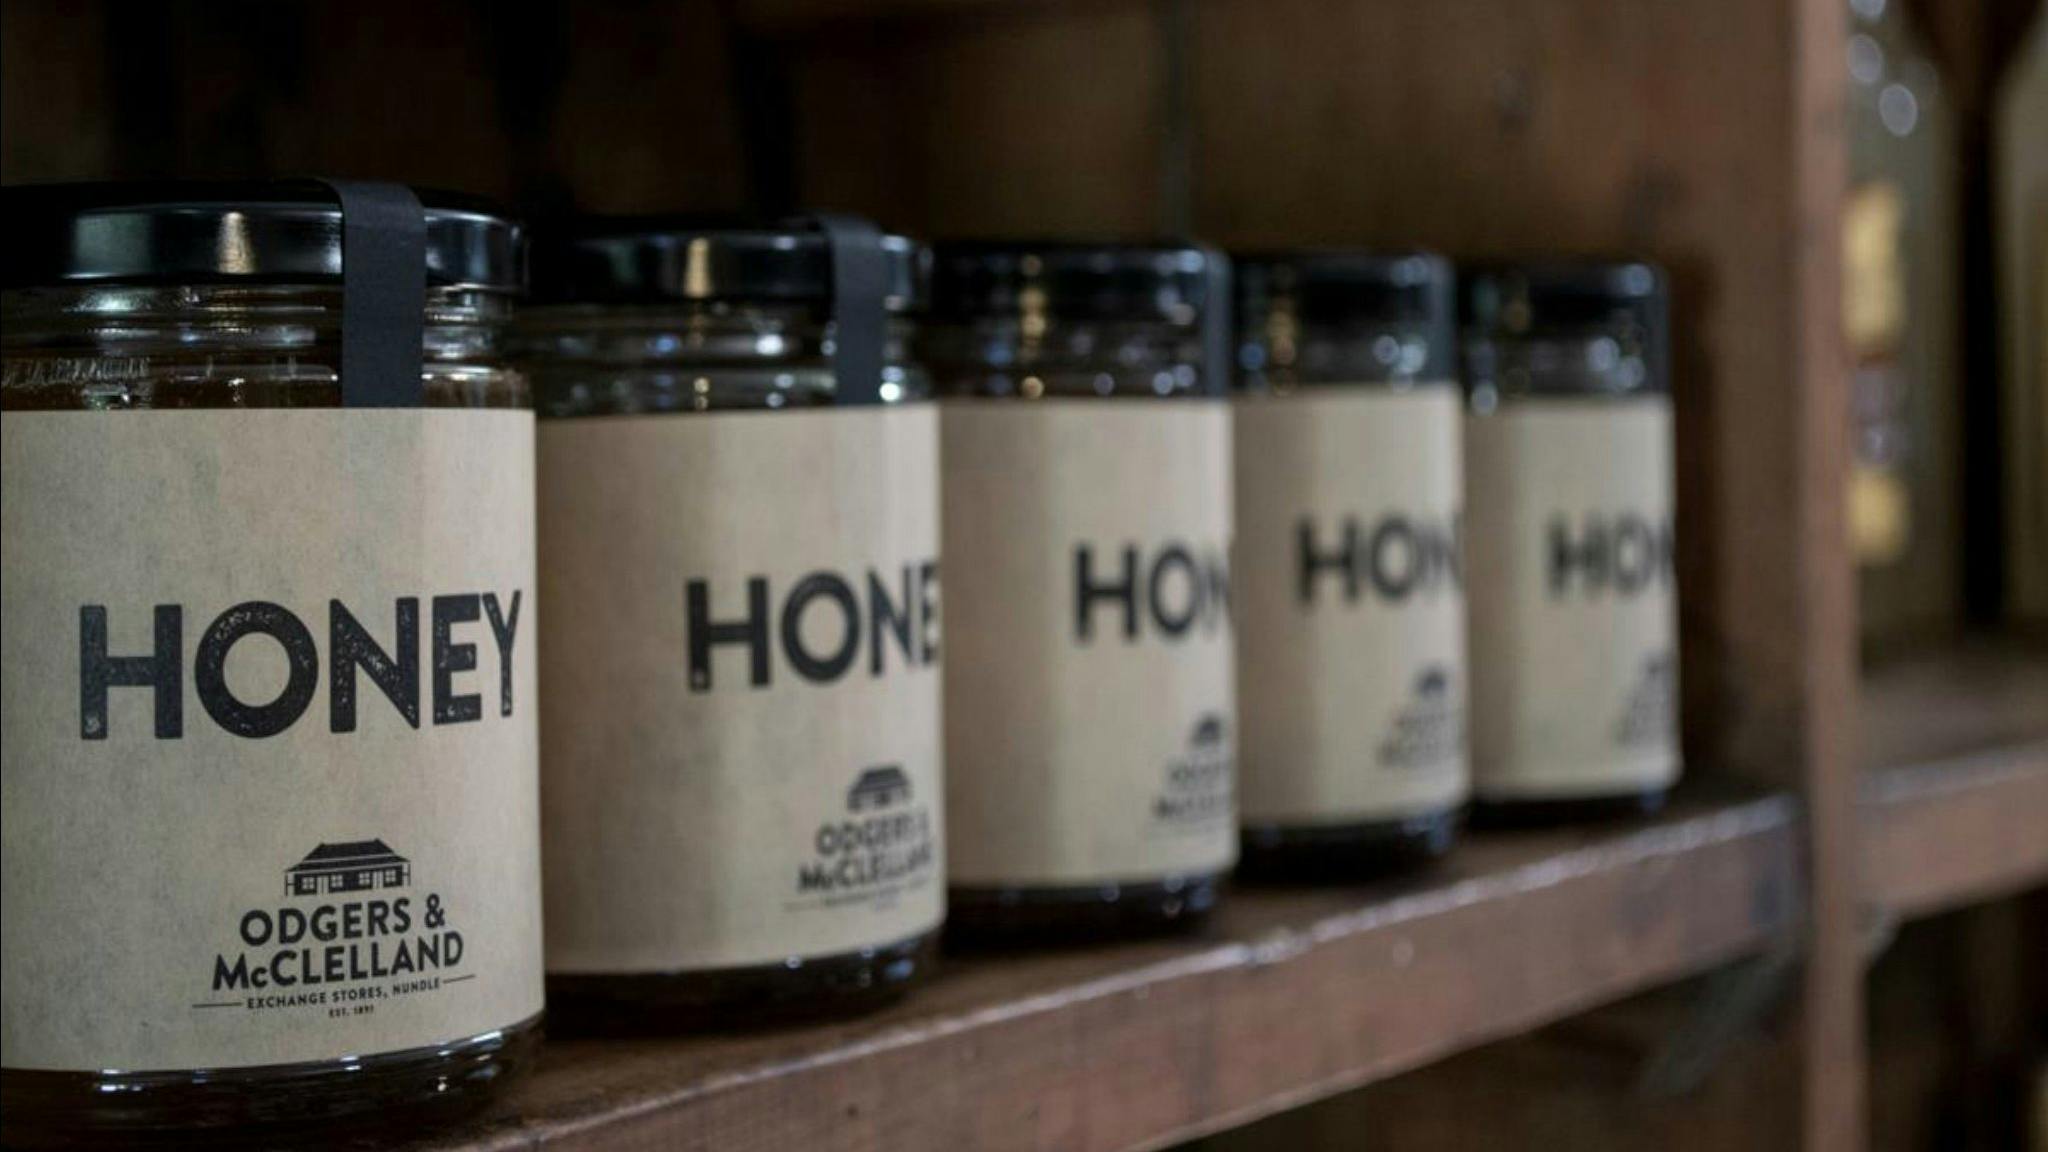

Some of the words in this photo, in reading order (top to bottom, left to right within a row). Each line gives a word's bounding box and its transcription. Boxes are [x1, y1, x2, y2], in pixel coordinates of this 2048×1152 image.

[686, 561, 938, 692] HONE
[79, 590, 521, 740] HONEY
[239, 897, 412, 947] ODGERS
[424, 893, 445, 929] &
[212, 930, 464, 990] McCLELLAND
[246, 992, 327, 1010] EXCHANGE
[331, 985, 388, 1003] STORES,
[392, 978, 441, 996] NUNDLE
[328, 1007, 350, 1019] EST.
